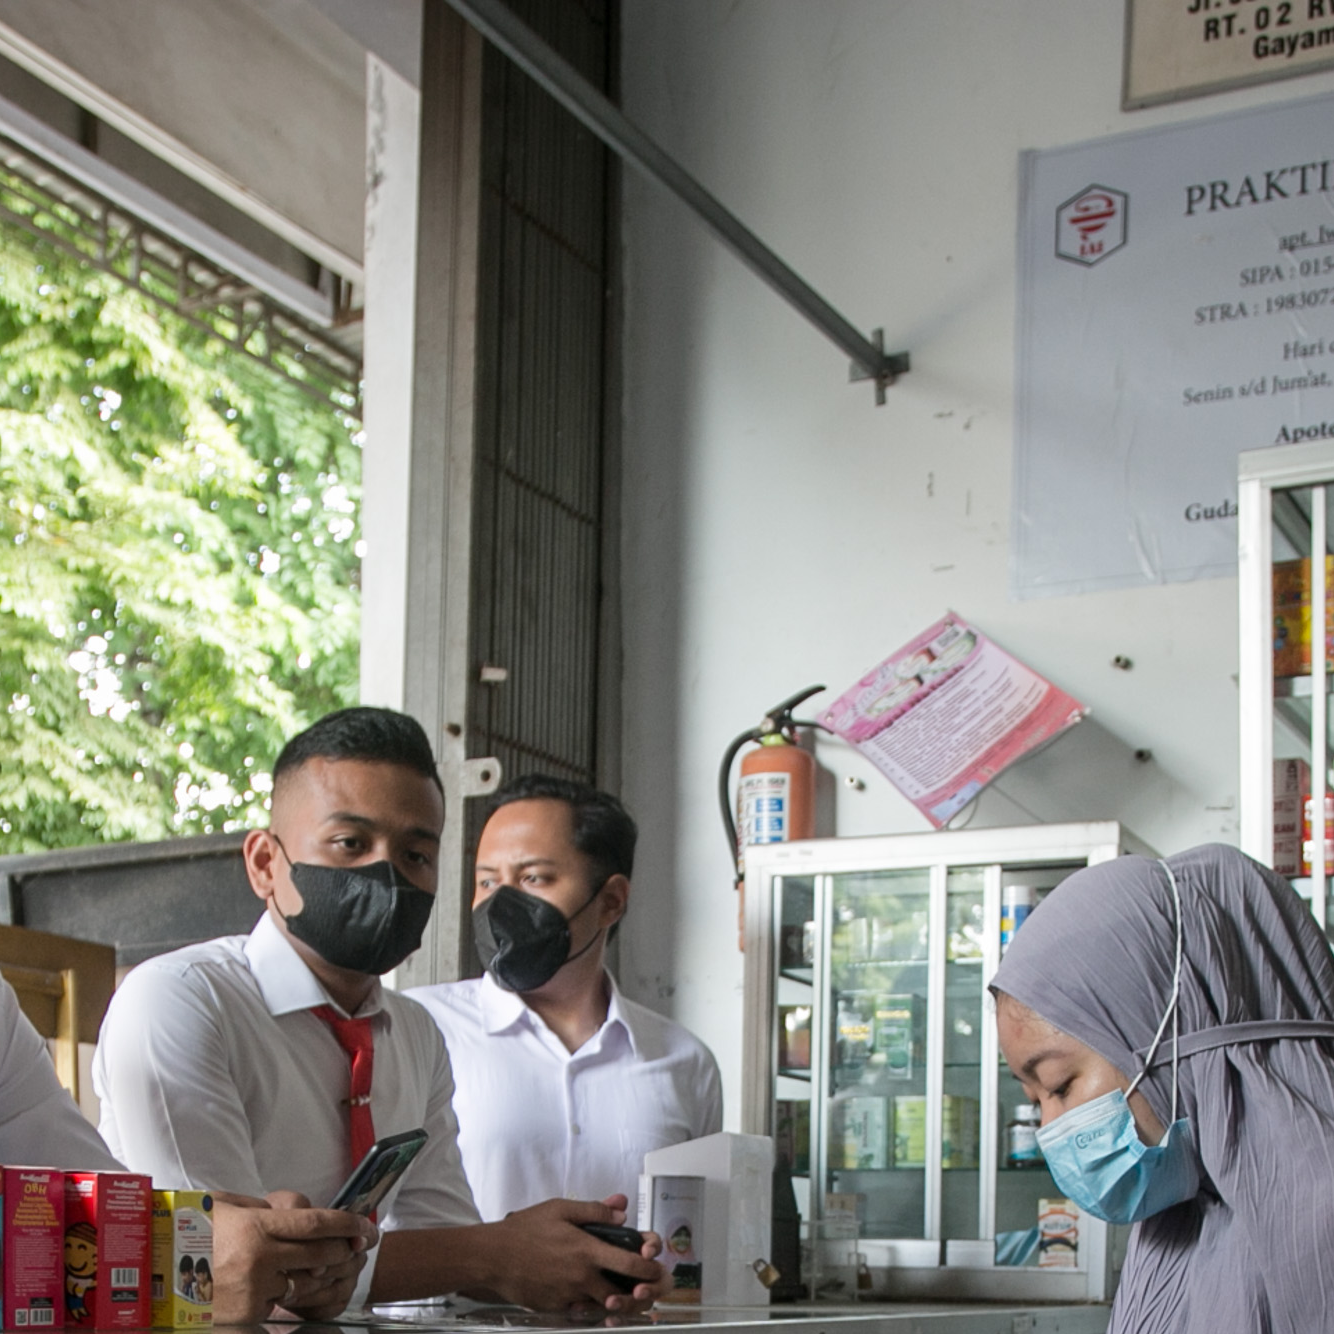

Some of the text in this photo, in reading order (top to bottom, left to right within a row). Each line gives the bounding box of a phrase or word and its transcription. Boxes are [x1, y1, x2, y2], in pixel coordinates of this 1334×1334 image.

[1204, 15, 1246, 43] RT.
[1254, 3, 1292, 33] 02
[1278, 231, 1312, 255] apt.
[1239, 265, 1285, 290] SIPA
[1193, 302, 1248, 327] STRA
[1282, 336, 1326, 363] Hari
[1182, 383, 1235, 406] Senin
[1238, 374, 1267, 398] s/d
